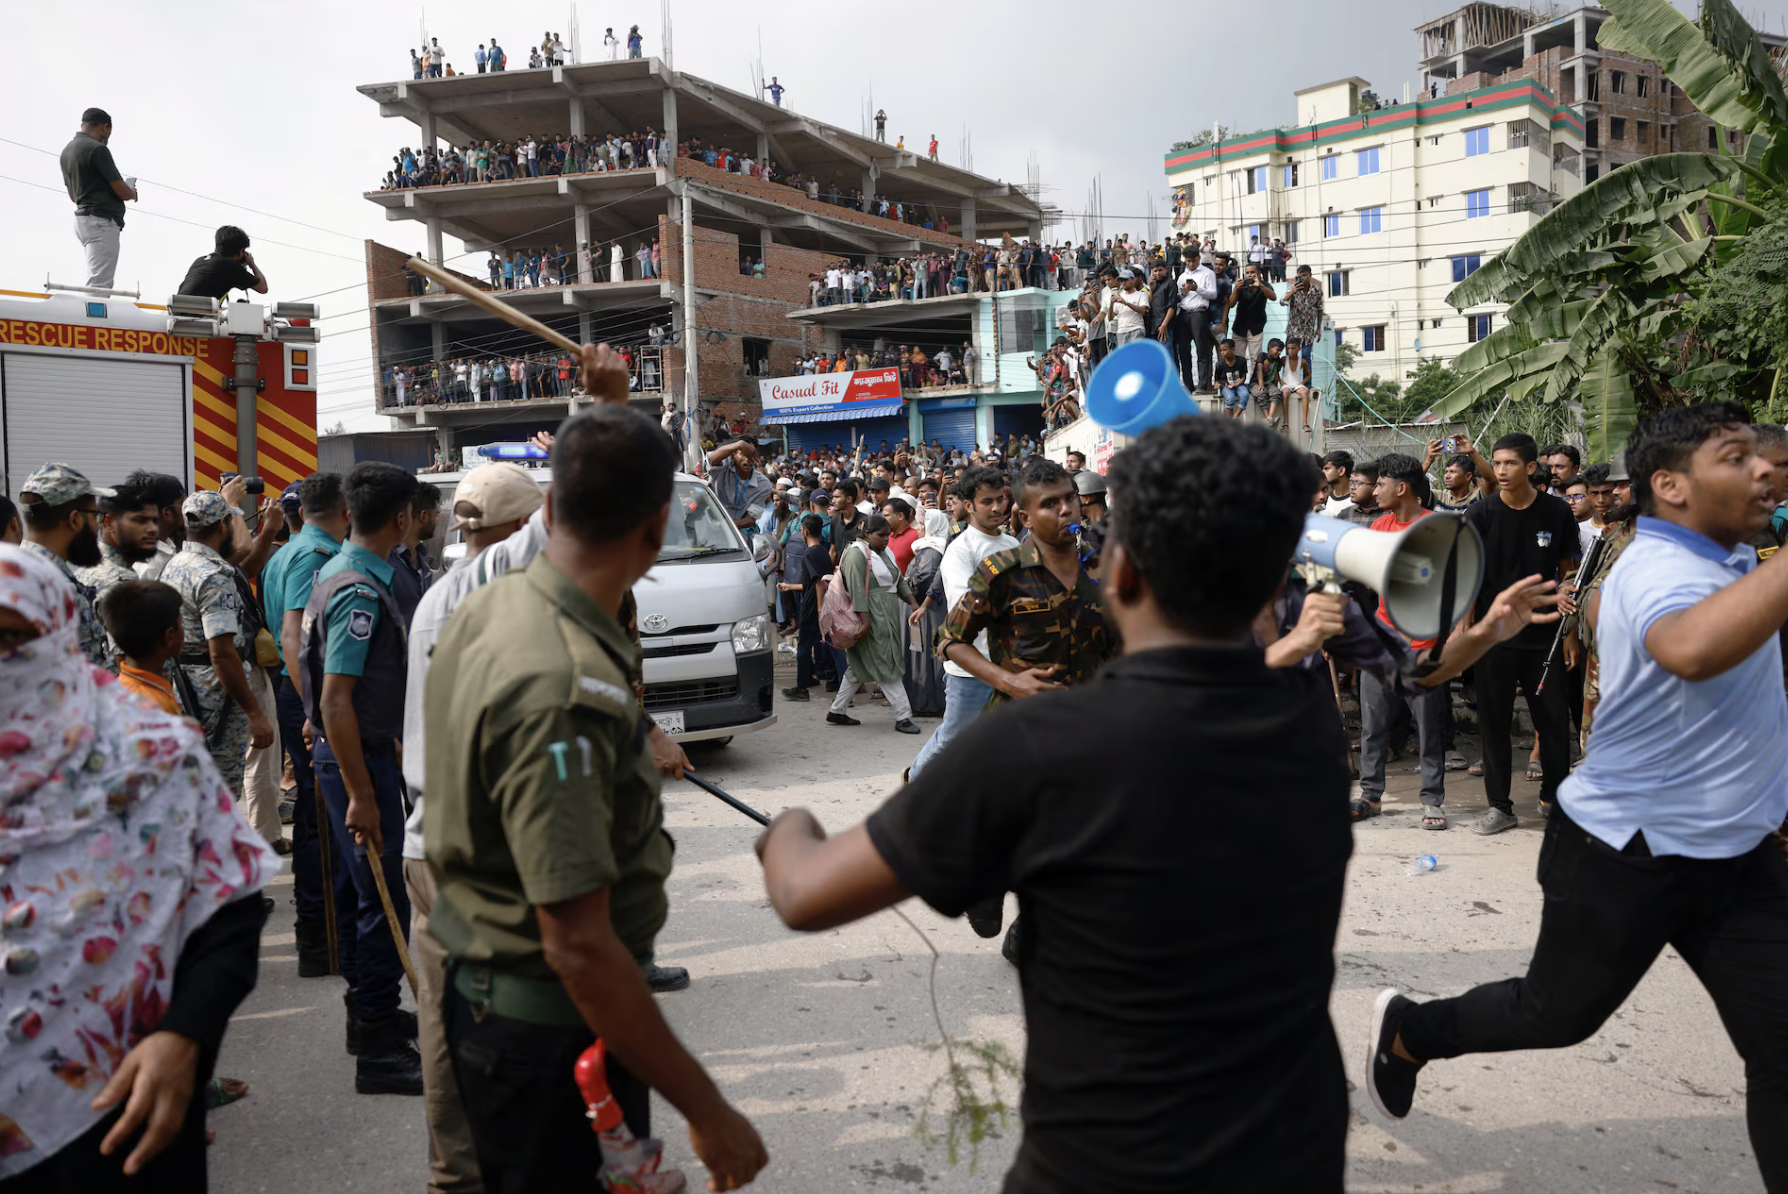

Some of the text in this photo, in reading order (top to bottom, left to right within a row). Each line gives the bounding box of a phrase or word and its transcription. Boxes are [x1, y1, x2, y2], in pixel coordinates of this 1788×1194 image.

[0, 320, 209, 358] RESCUE RESPONSE
[772, 382, 817, 400] Casual
[821, 380, 840, 396] Fit
